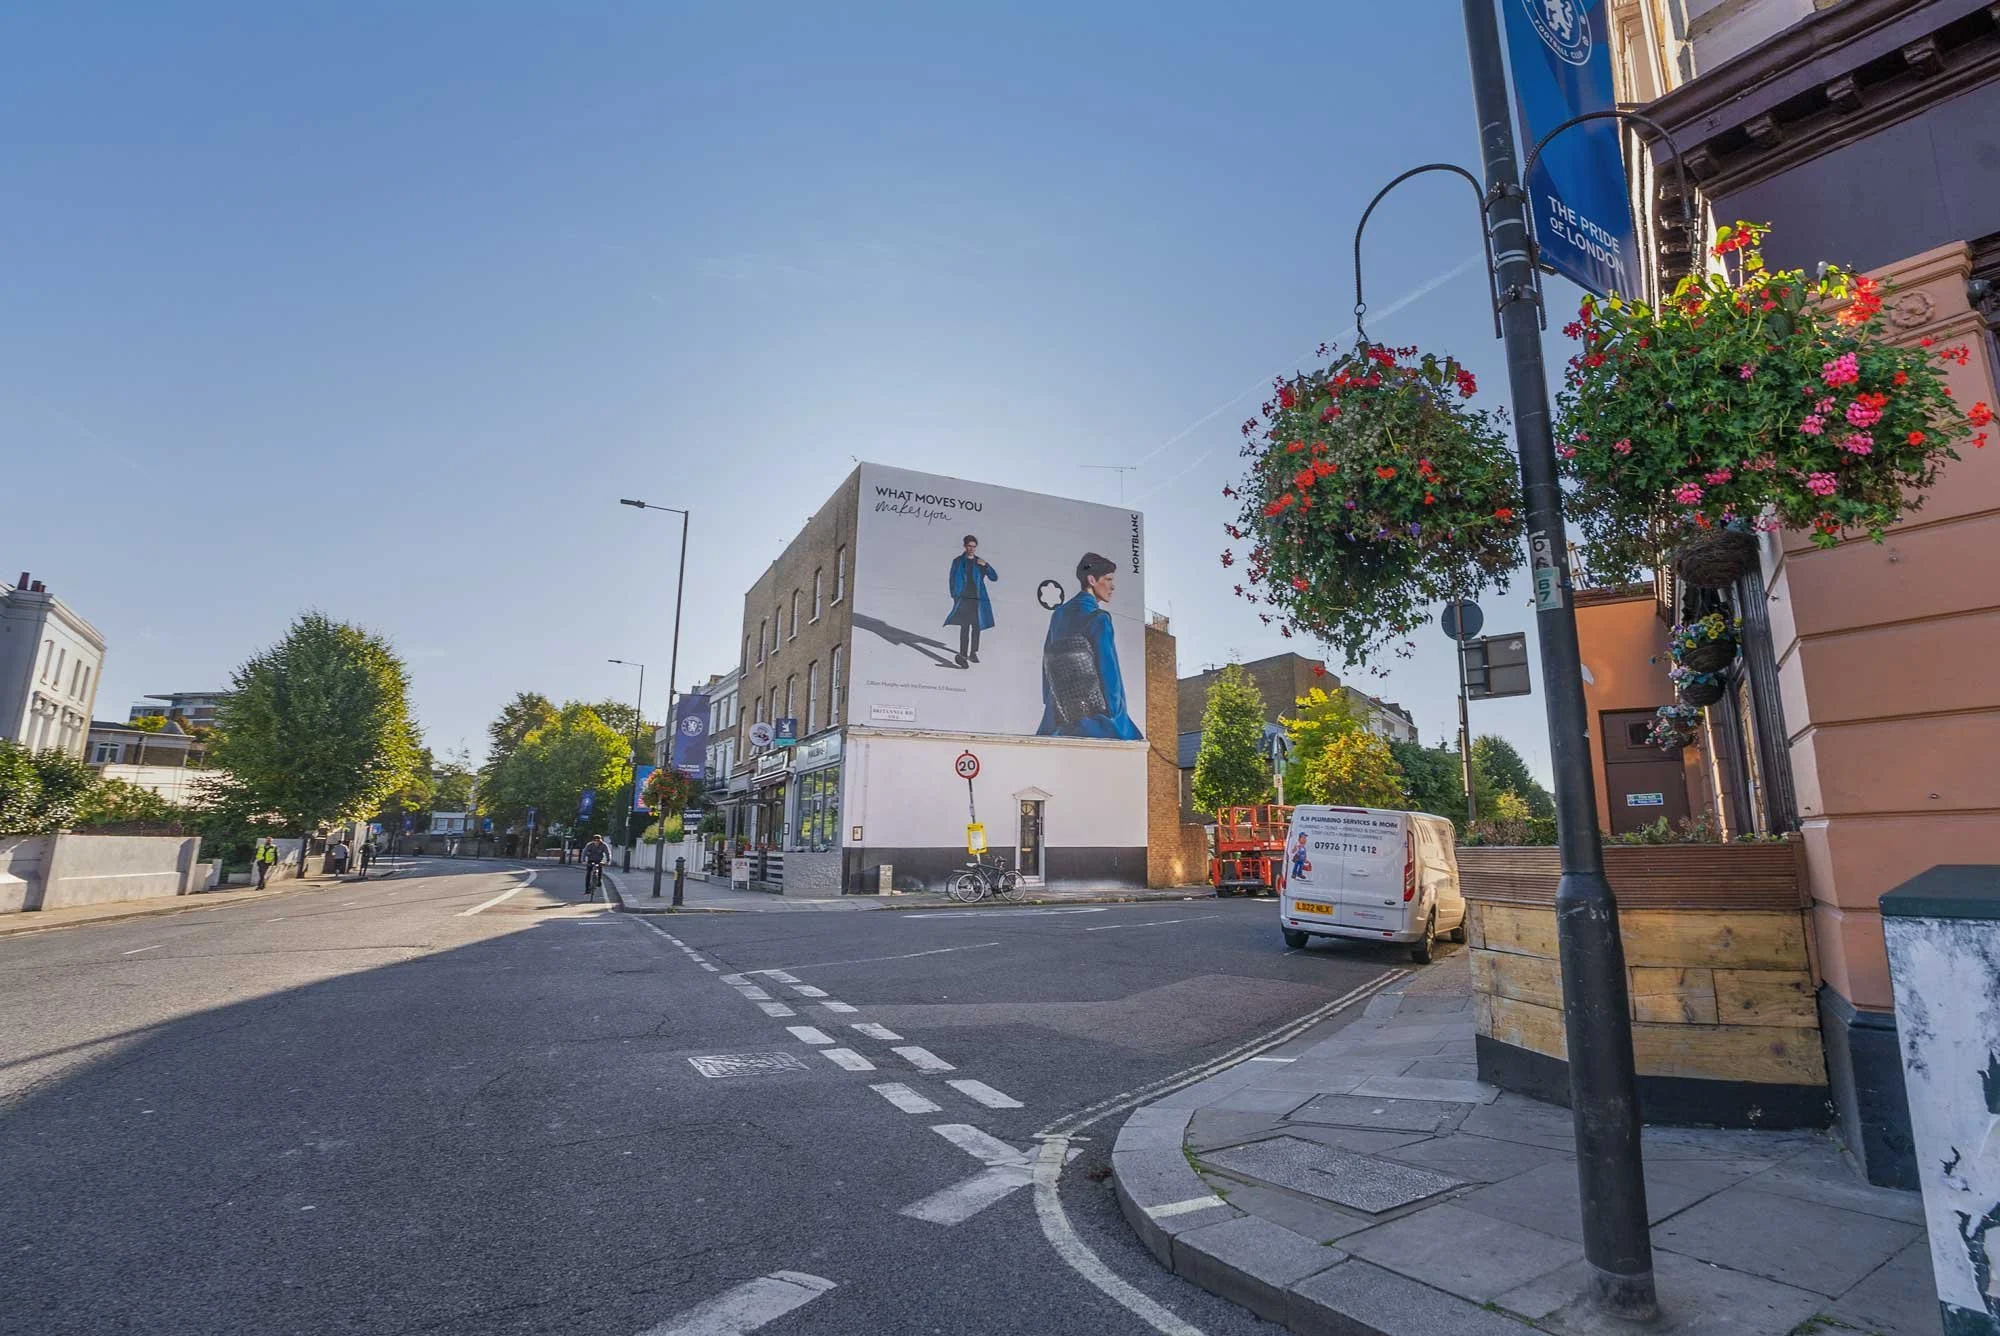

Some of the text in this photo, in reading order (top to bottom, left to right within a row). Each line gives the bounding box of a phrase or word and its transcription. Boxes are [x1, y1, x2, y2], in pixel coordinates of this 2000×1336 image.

[1547, 195, 1621, 254] THE PRIDE
[1550, 217, 1625, 276] OF LONDON
[875, 486, 983, 512] WHAT MOVES YOU
[923, 509, 953, 526] you
[1131, 513, 1140, 574] MONTBLANC
[958, 760, 976, 772] 20
[1314, 841, 1377, 854] 07976 711 412
